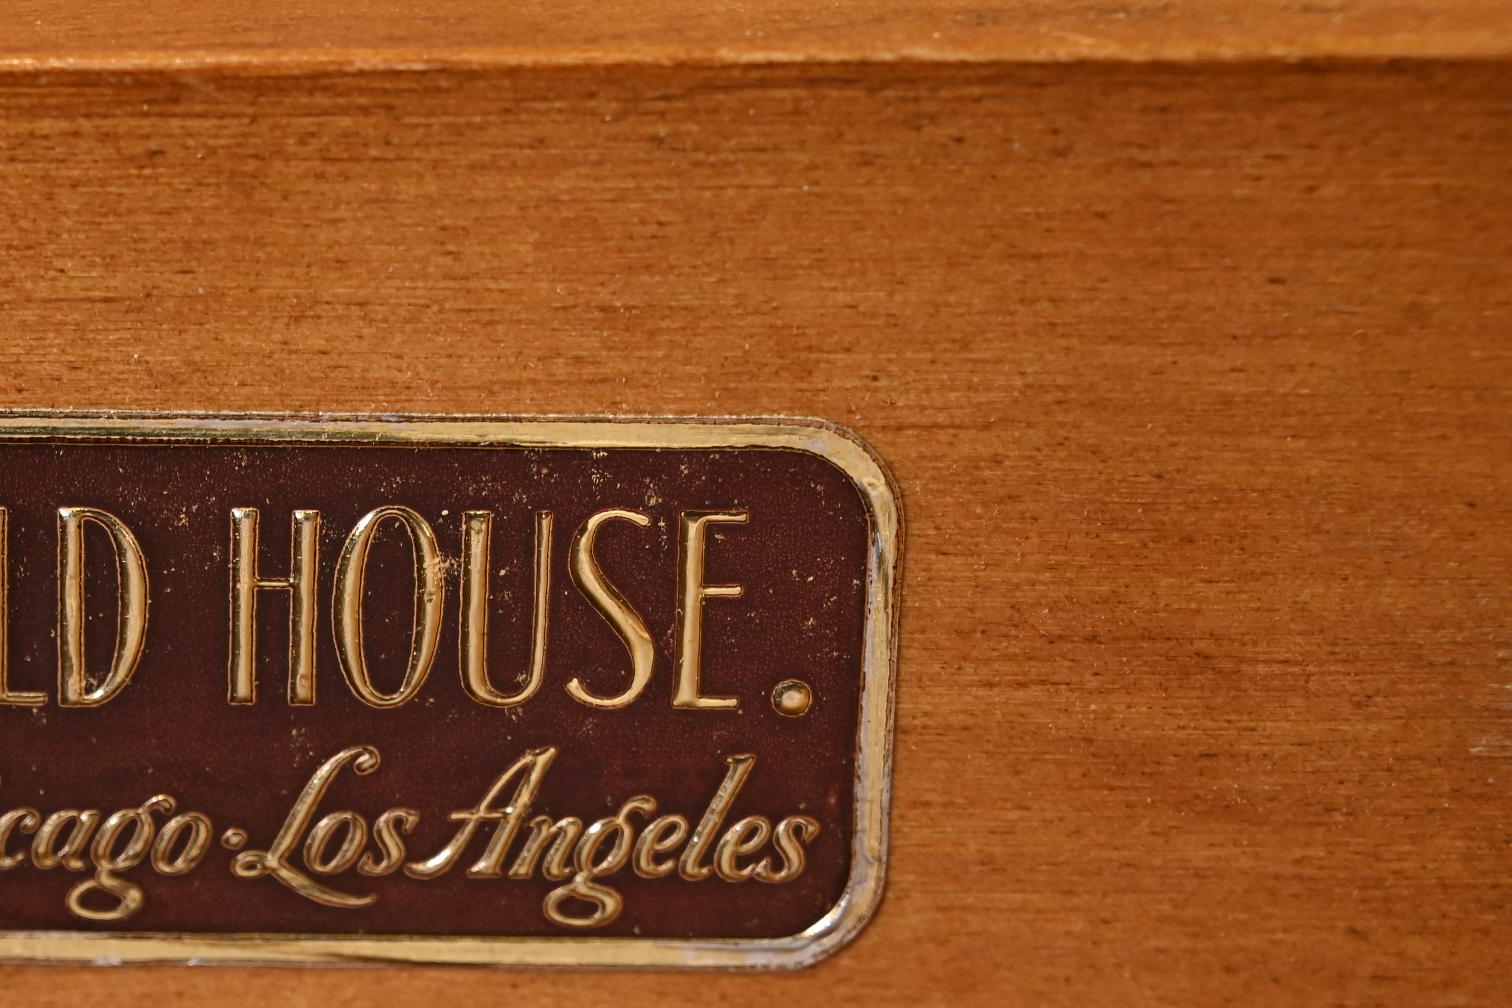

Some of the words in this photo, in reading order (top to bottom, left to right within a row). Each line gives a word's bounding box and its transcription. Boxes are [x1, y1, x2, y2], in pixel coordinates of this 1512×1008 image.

[227, 504, 751, 710] HOUSE
[230, 744, 420, 908] Los
[405, 745, 821, 928] Angeles
